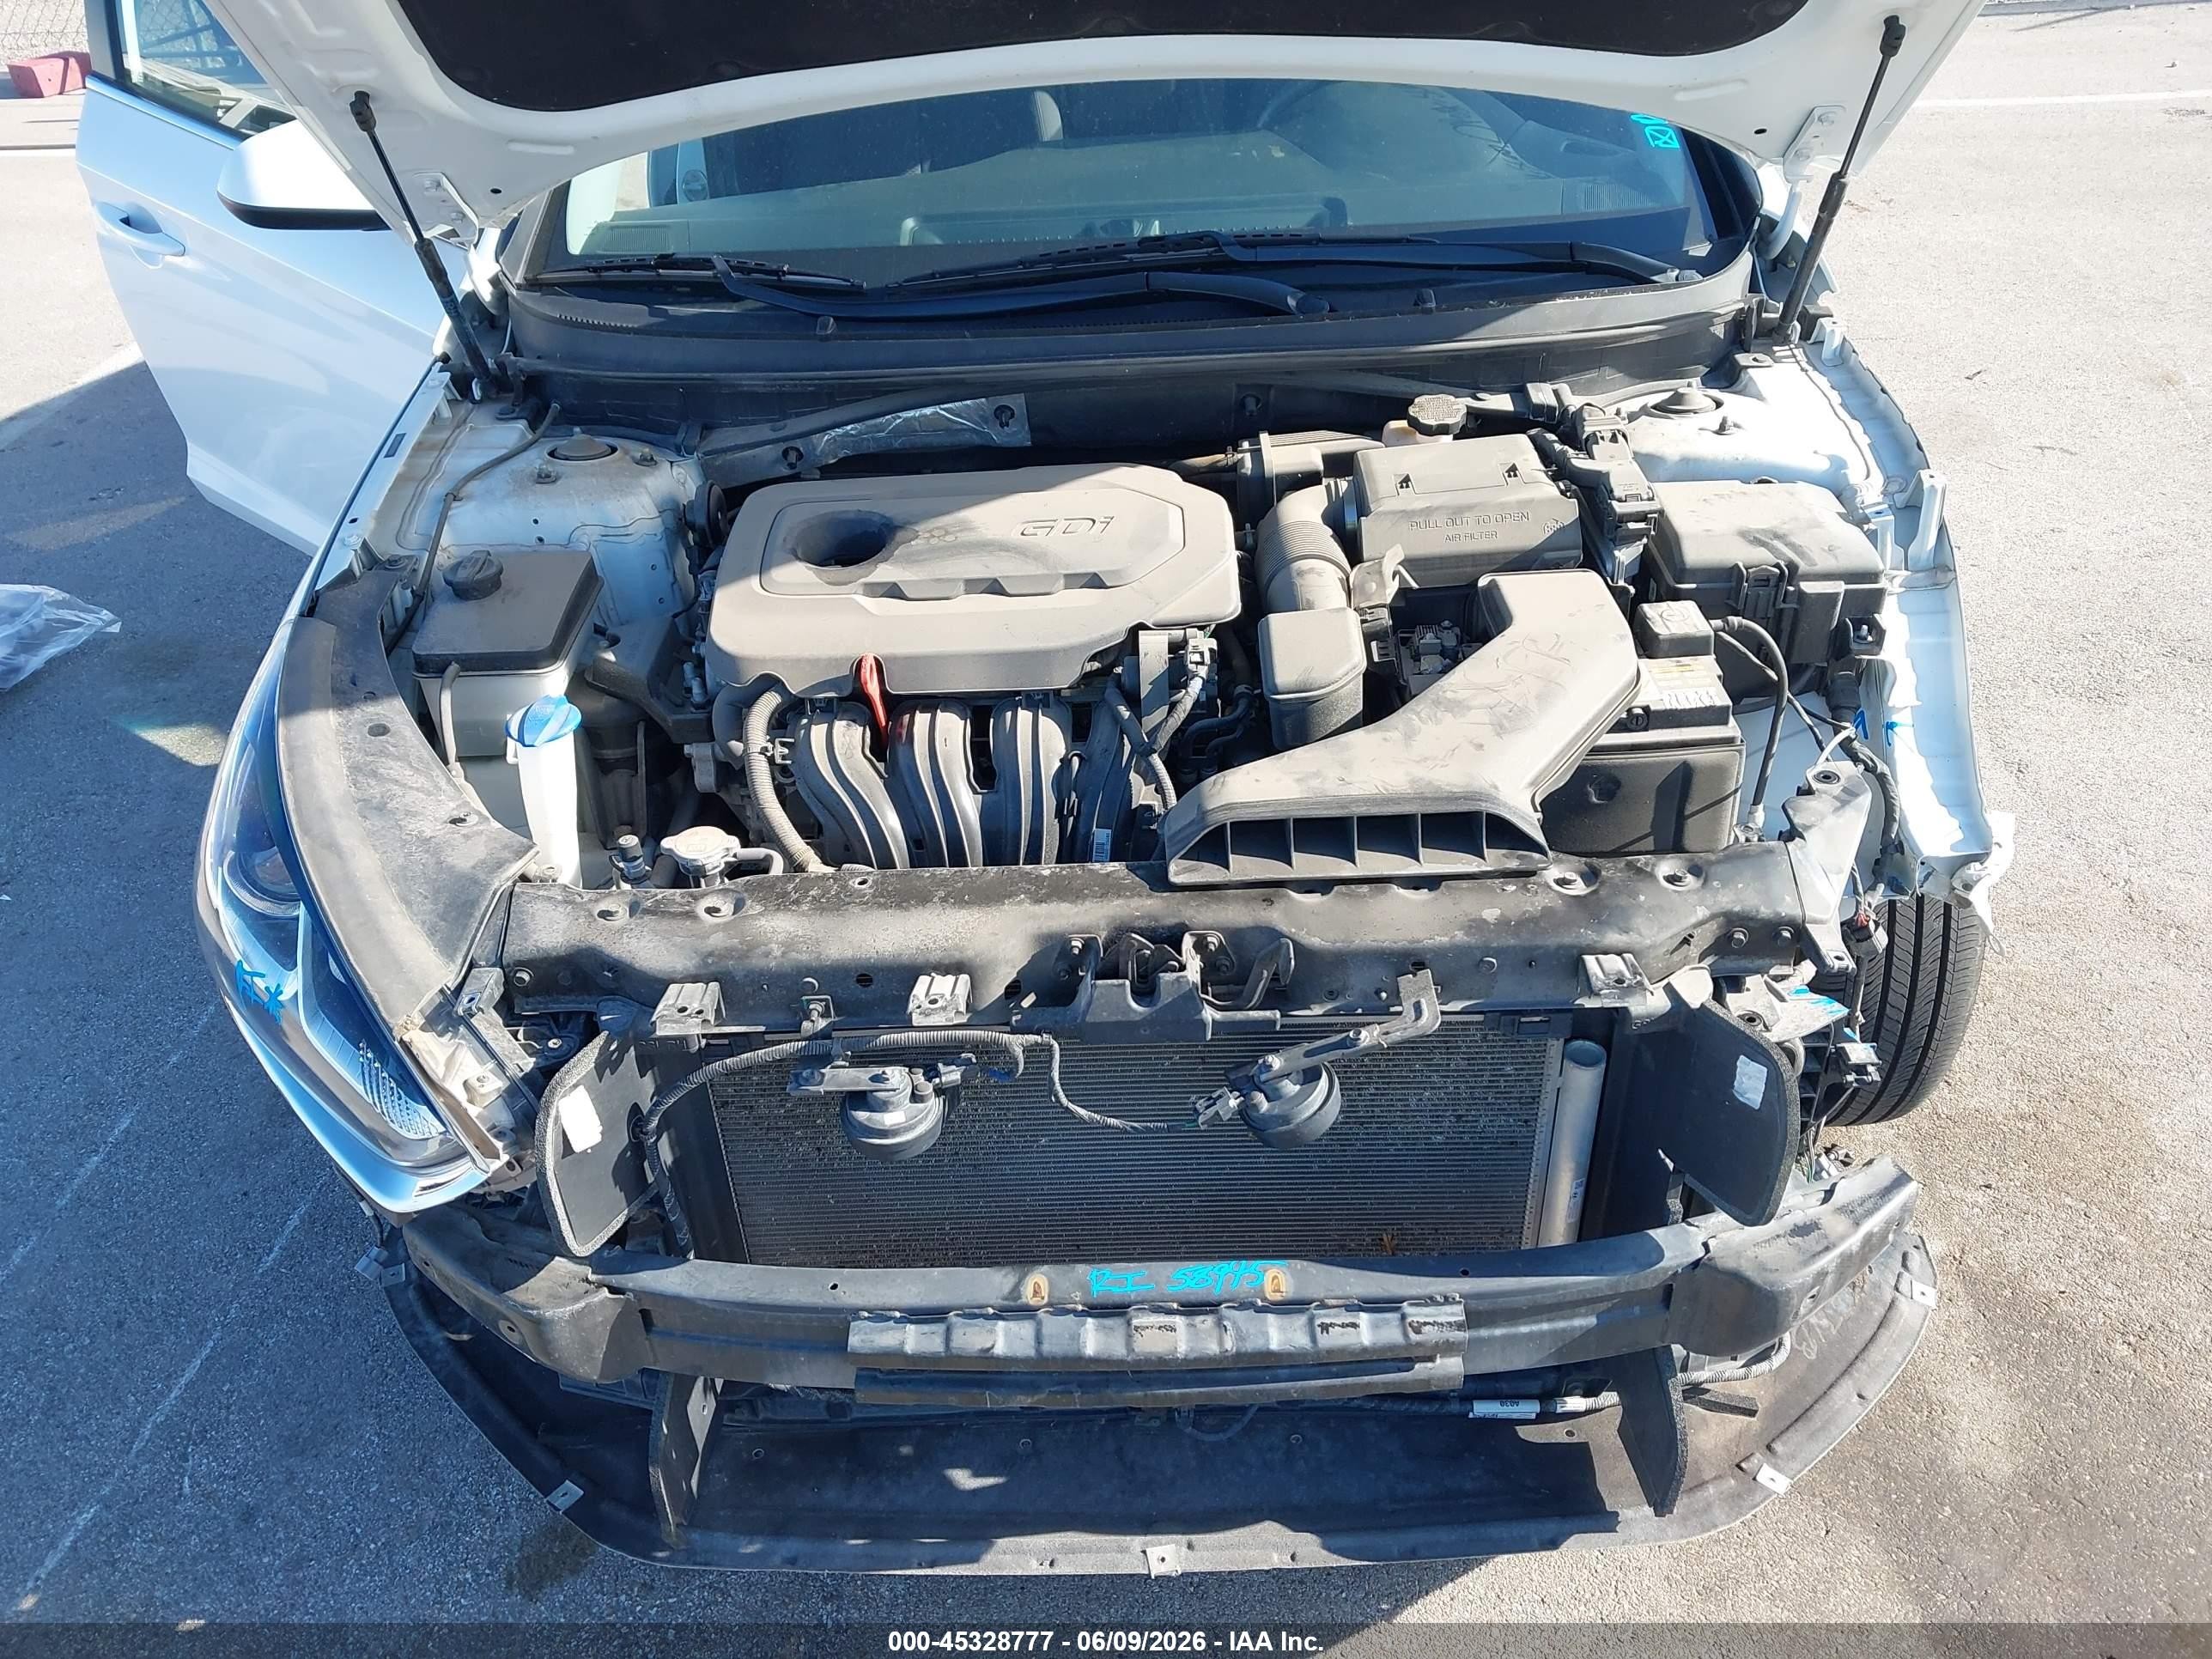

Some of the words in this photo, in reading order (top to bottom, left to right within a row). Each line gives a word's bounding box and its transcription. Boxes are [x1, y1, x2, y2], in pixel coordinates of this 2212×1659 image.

[1408, 520, 1443, 531] PULL
[1445, 516, 1471, 528] OUT
[1474, 514, 1492, 526] TO
[1495, 511, 1530, 524] OPEN
[1443, 533, 1462, 544] AIR
[1464, 530, 1498, 542] FILTER
